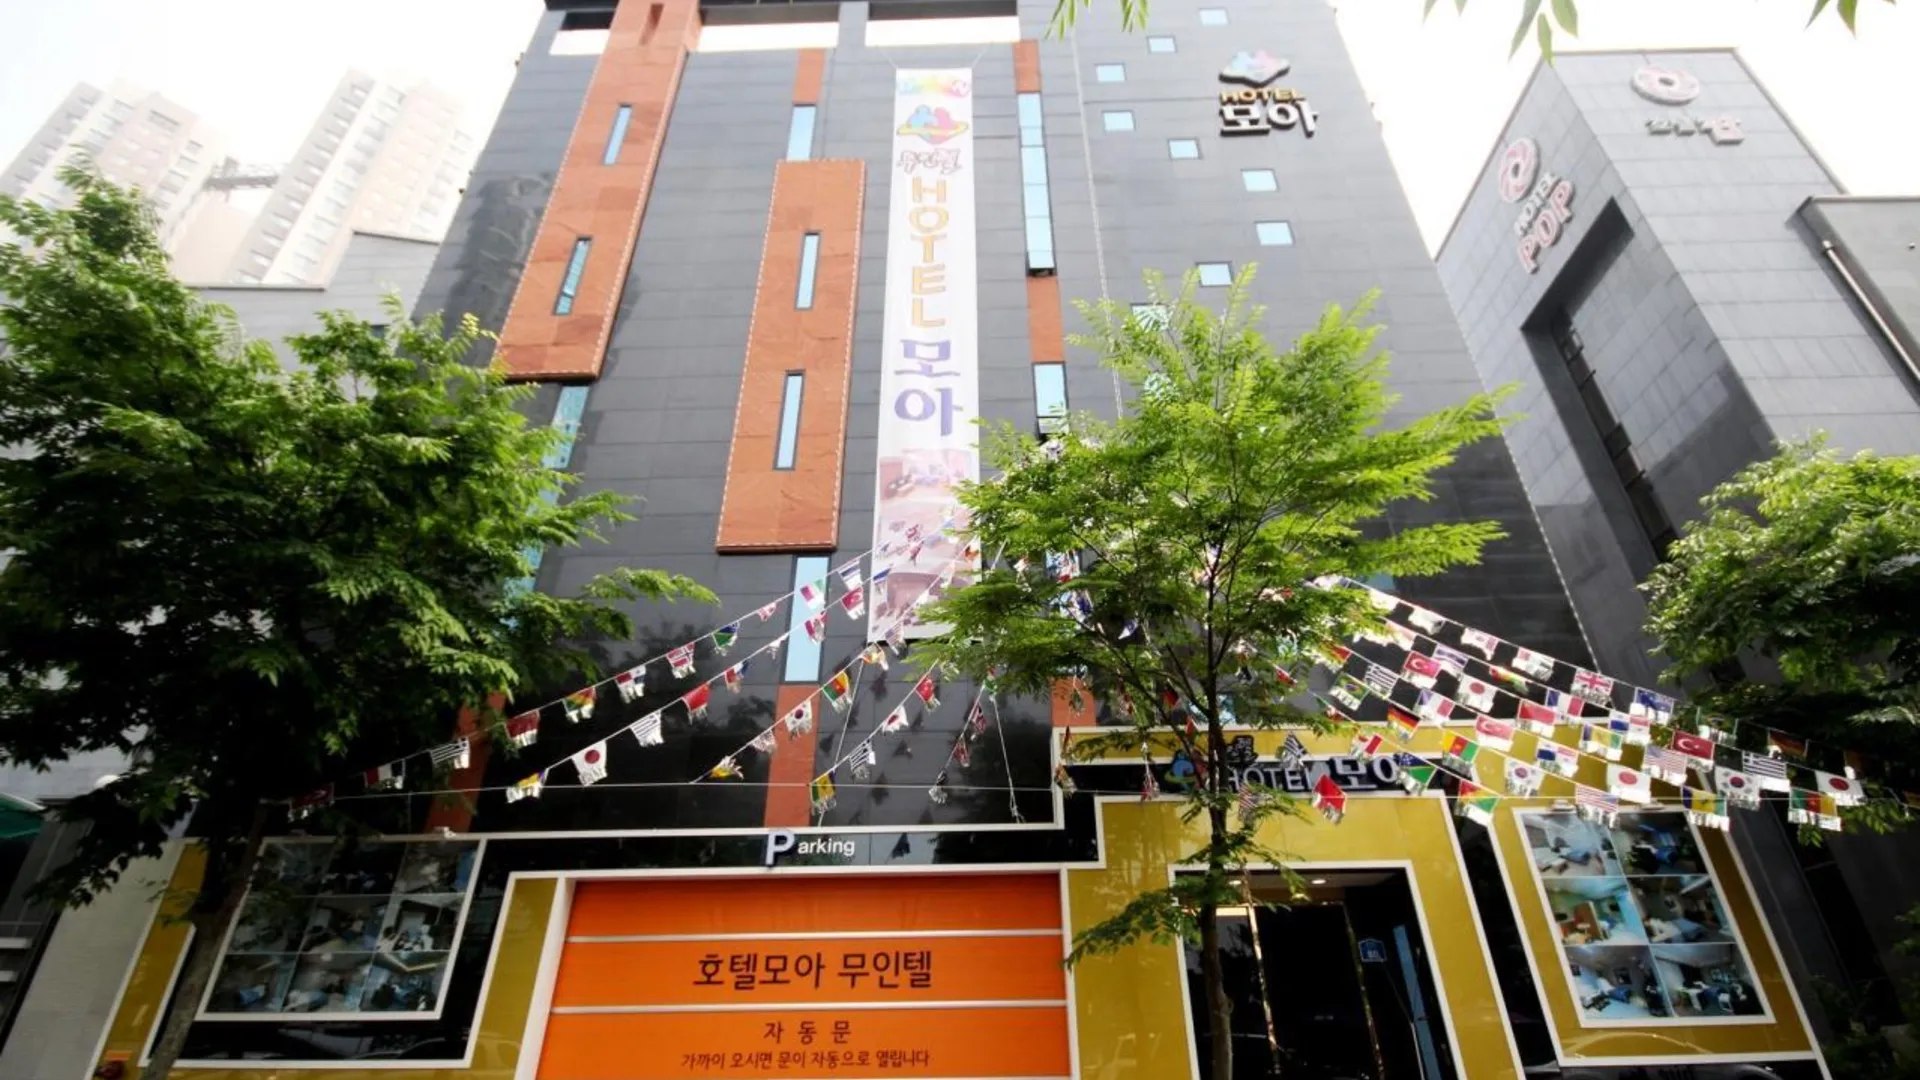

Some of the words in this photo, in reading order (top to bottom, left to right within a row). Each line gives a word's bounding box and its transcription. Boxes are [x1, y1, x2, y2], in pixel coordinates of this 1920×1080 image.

[1220, 87, 1305, 106] HOTEL
[1220, 100, 1320, 138] 모아
[1513, 171, 1562, 238] HOTEL
[1517, 180, 1575, 274] POP
[909, 176, 949, 329] HOTEL
[894, 339, 964, 437] 모아
[765, 830, 855, 866] Parking
[693, 952, 825, 990] 호텔모아
[838, 950, 932, 988] 무인텔
[681, 1053, 725, 1070] 가까이
[729, 1052, 772, 1070] 오시면
[777, 1051, 806, 1069] 문이
[812, 1050, 870, 1069] 자동으로
[876, 1048, 930, 1068] 열립니다
